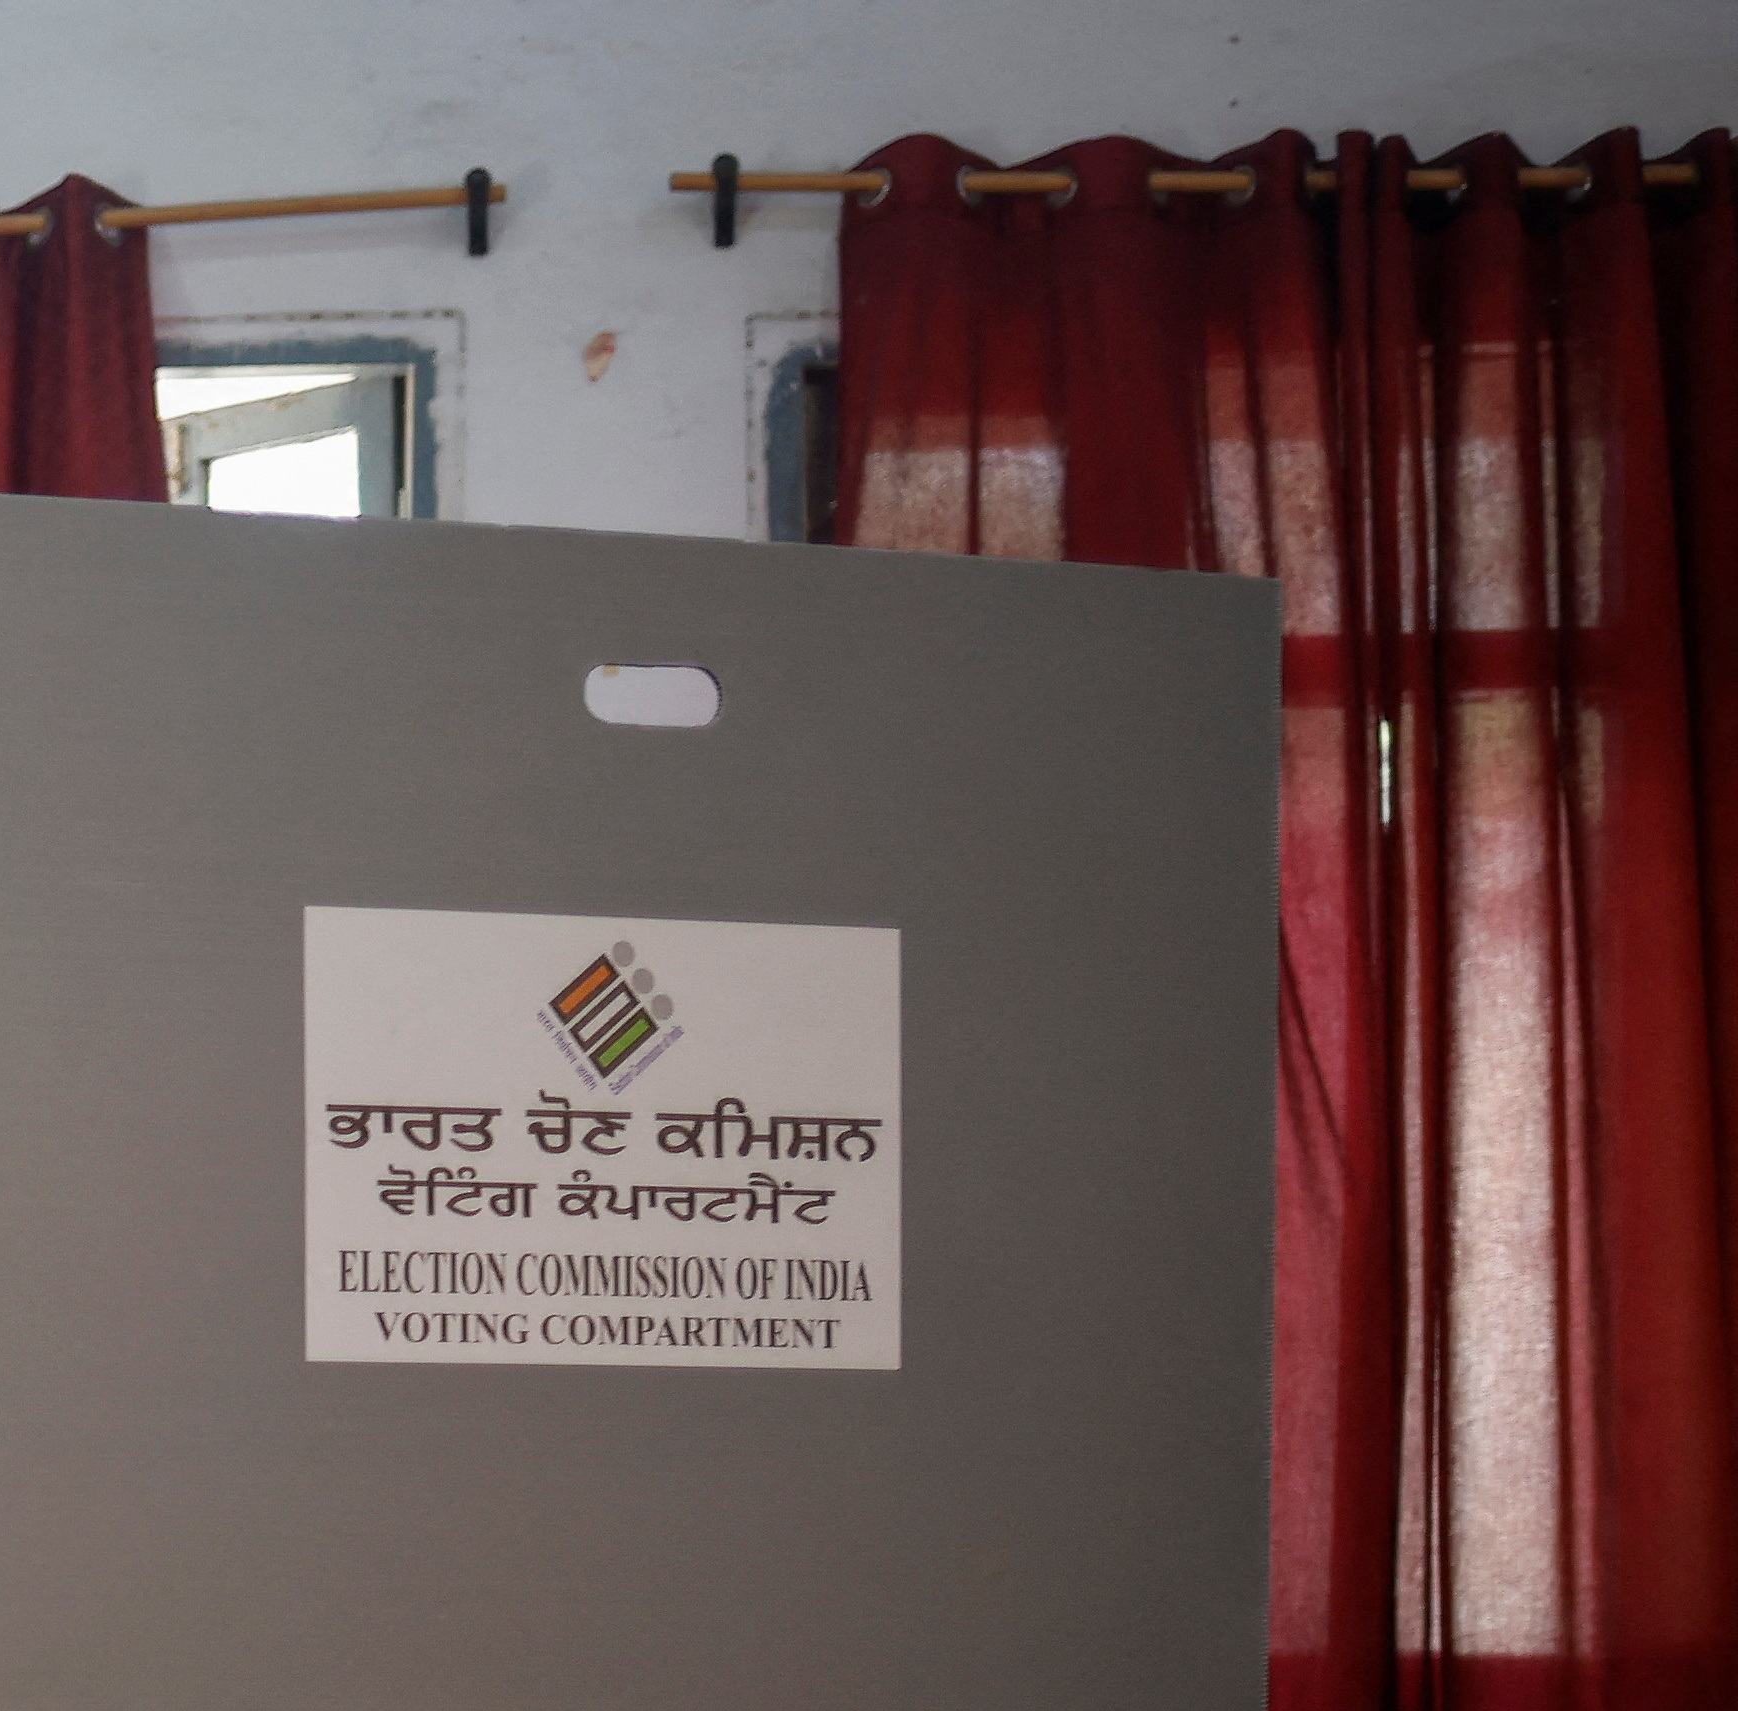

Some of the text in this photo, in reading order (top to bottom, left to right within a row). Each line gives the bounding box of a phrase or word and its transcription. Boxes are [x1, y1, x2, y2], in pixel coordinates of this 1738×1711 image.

[326, 1090, 882, 1162] ਭਾਰਤ ਚੋਣ ਕਮਿਸ਼ਨ
[377, 1164, 835, 1224] ਵੋਟਿੰਗ ਕੰਪਾਰਟਮੈਂਟ
[339, 1250, 873, 1302] ELECTION COMMISSION OF INDIA
[374, 1311, 841, 1349] VOTING COMPARTMENT
